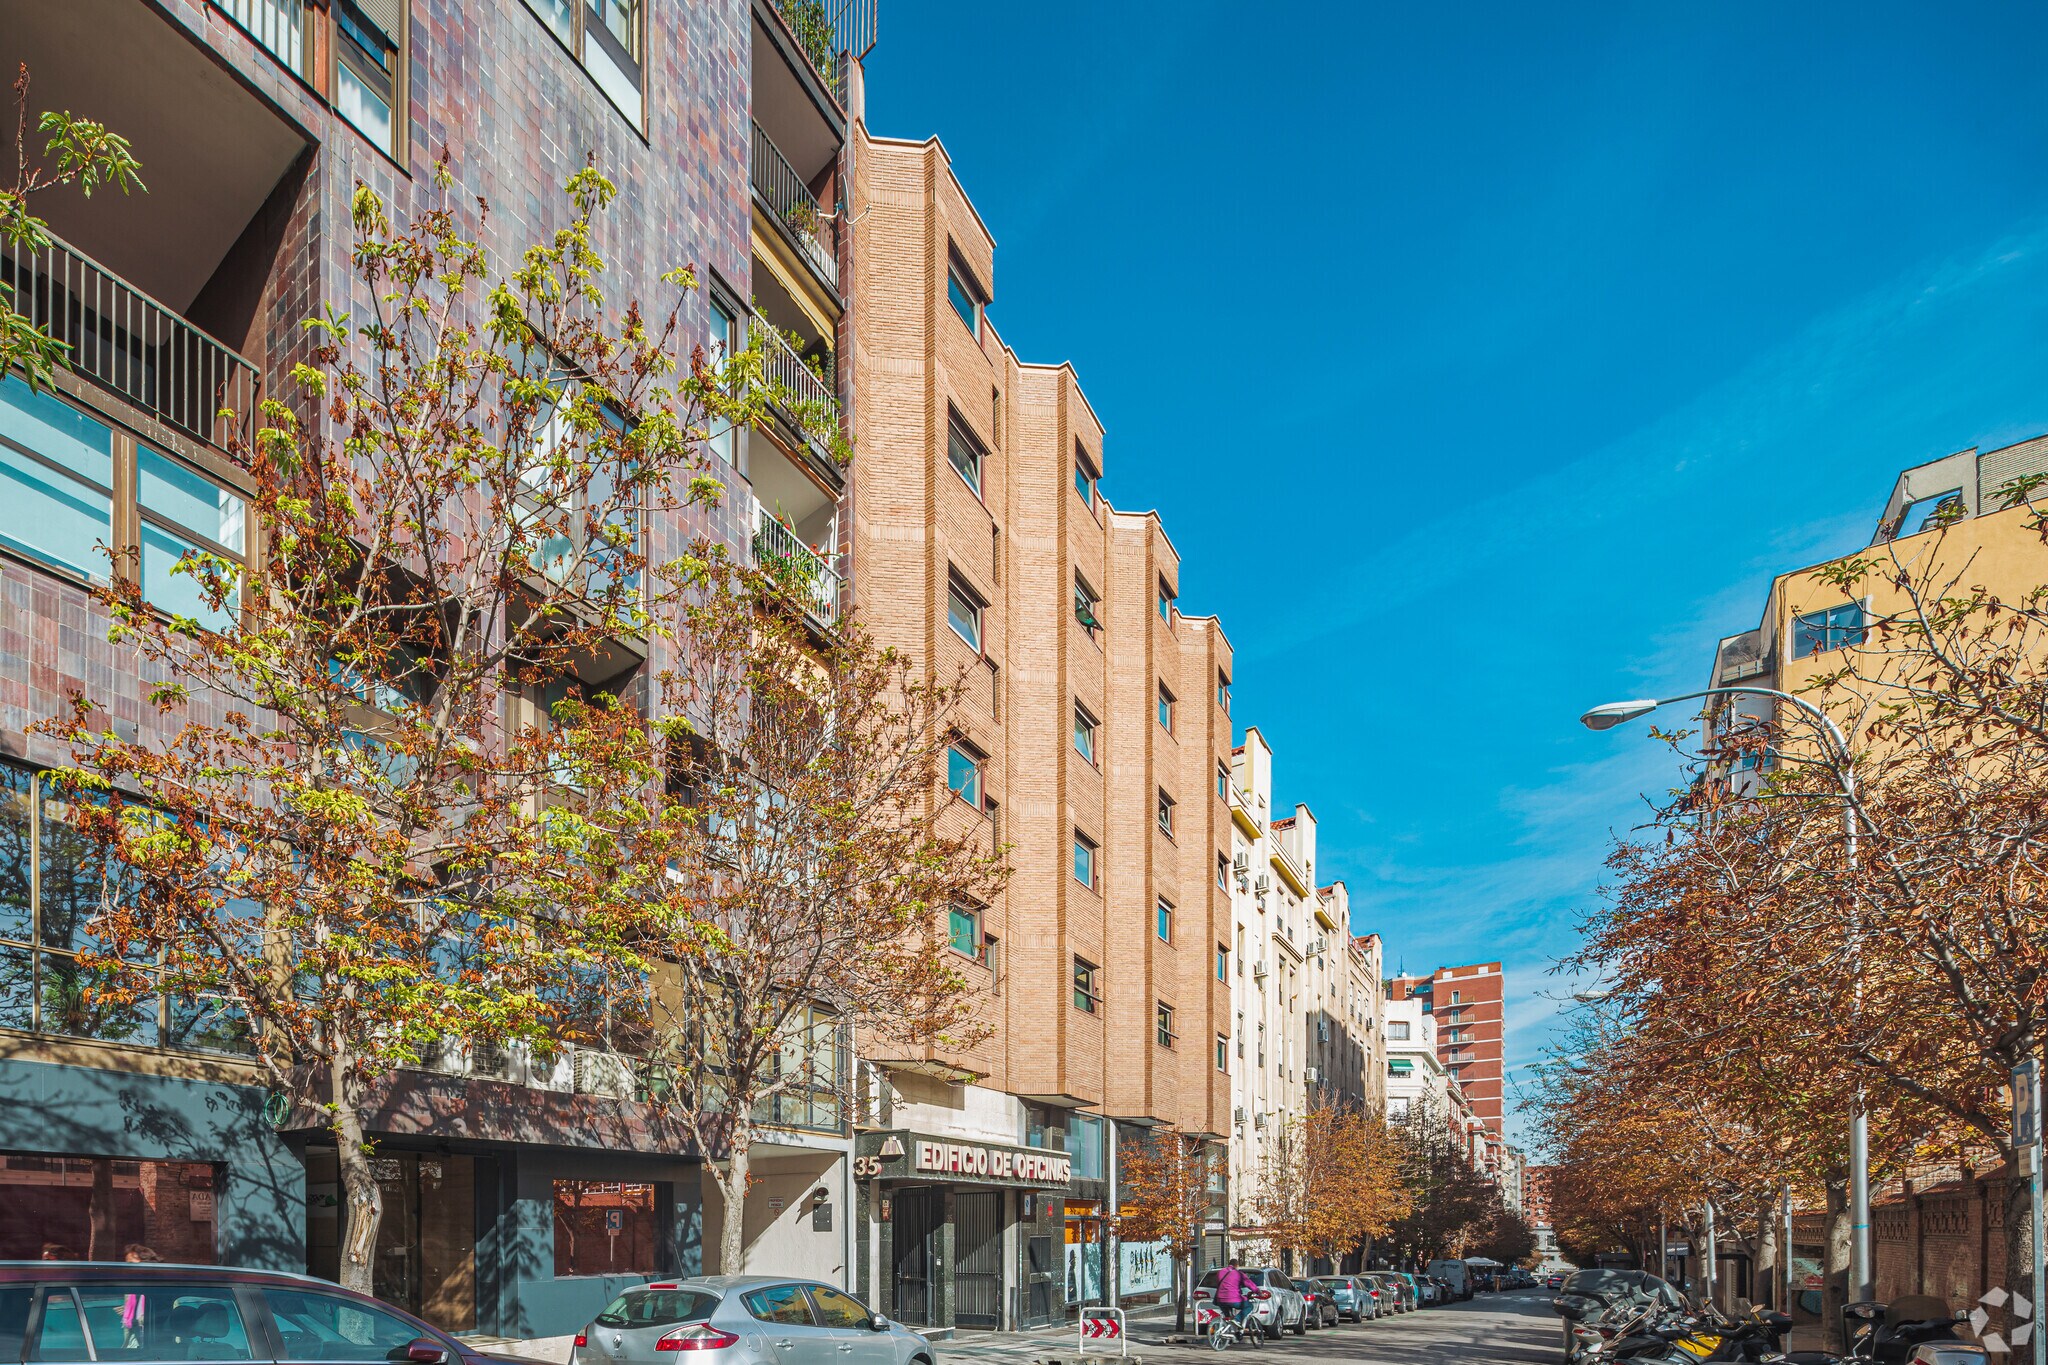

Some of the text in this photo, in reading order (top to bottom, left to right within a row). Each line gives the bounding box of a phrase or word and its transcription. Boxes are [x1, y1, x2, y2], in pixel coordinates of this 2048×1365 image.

[2016, 1073, 2029, 1137] P
[855, 1156, 881, 1176] 35
[917, 1141, 1071, 1183] EDIFICIO DE OFICINAS
